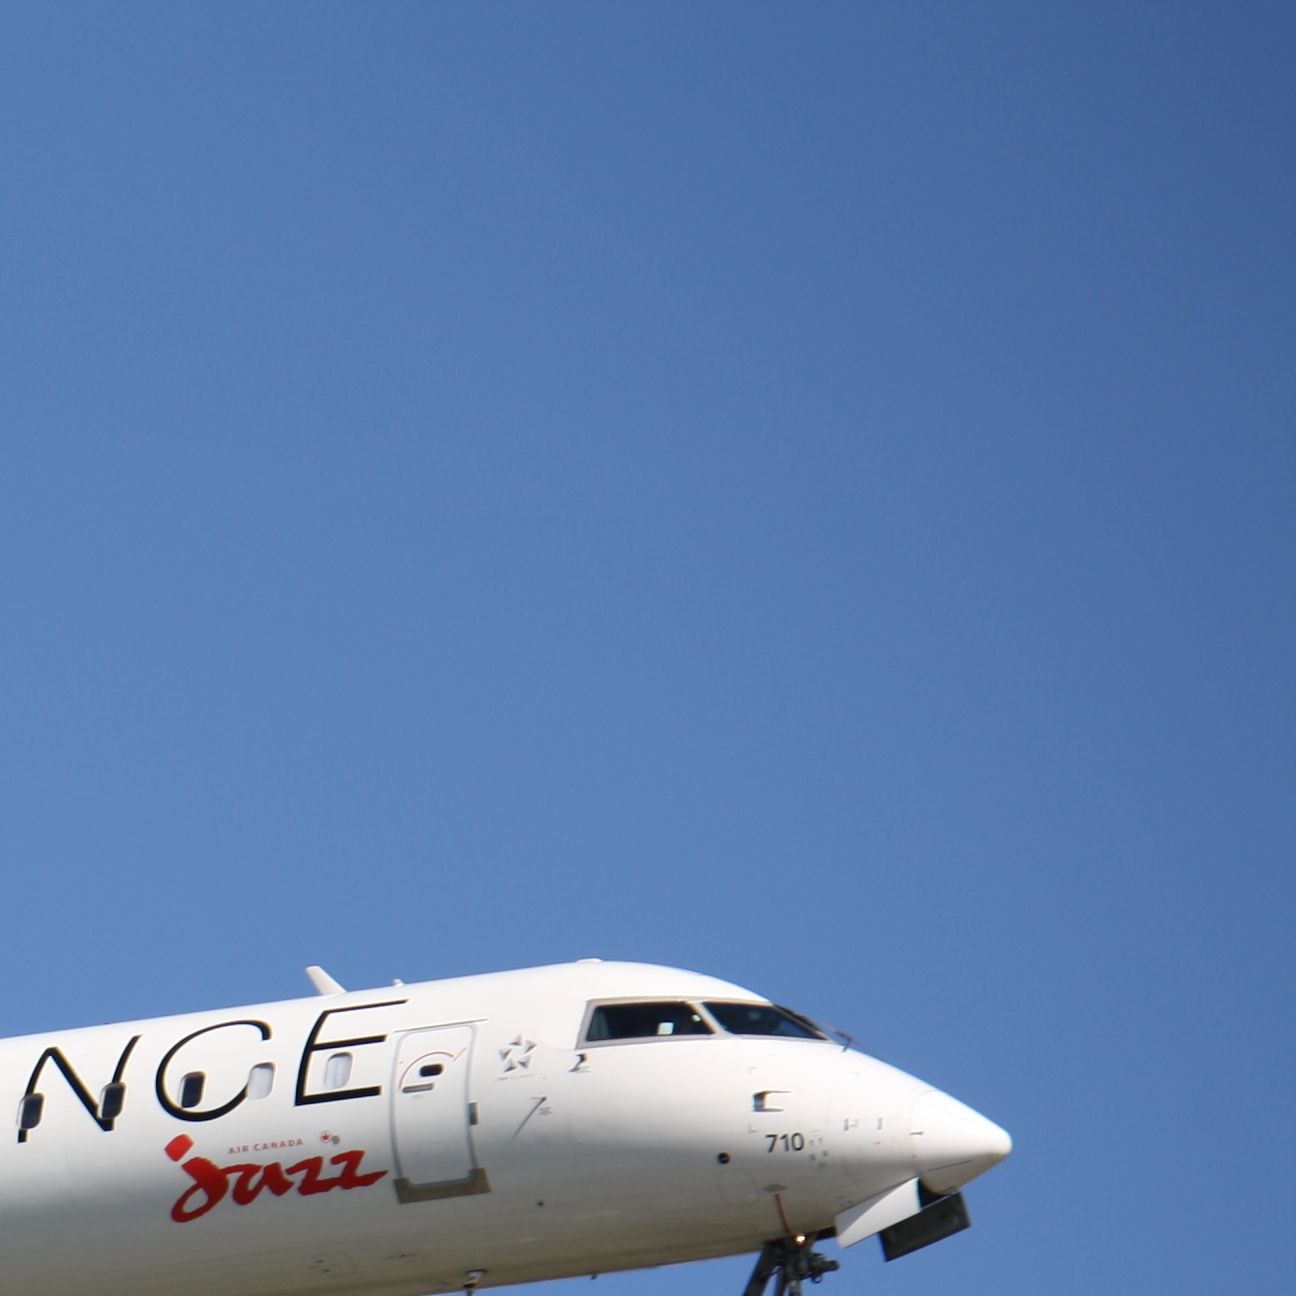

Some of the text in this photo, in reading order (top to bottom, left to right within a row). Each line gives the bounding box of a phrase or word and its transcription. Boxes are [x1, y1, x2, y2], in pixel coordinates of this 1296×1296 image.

[228, 1138, 304, 1154] AIR CANADA
[765, 1132, 805, 1153] 710
[165, 1133, 389, 1223] jazz
